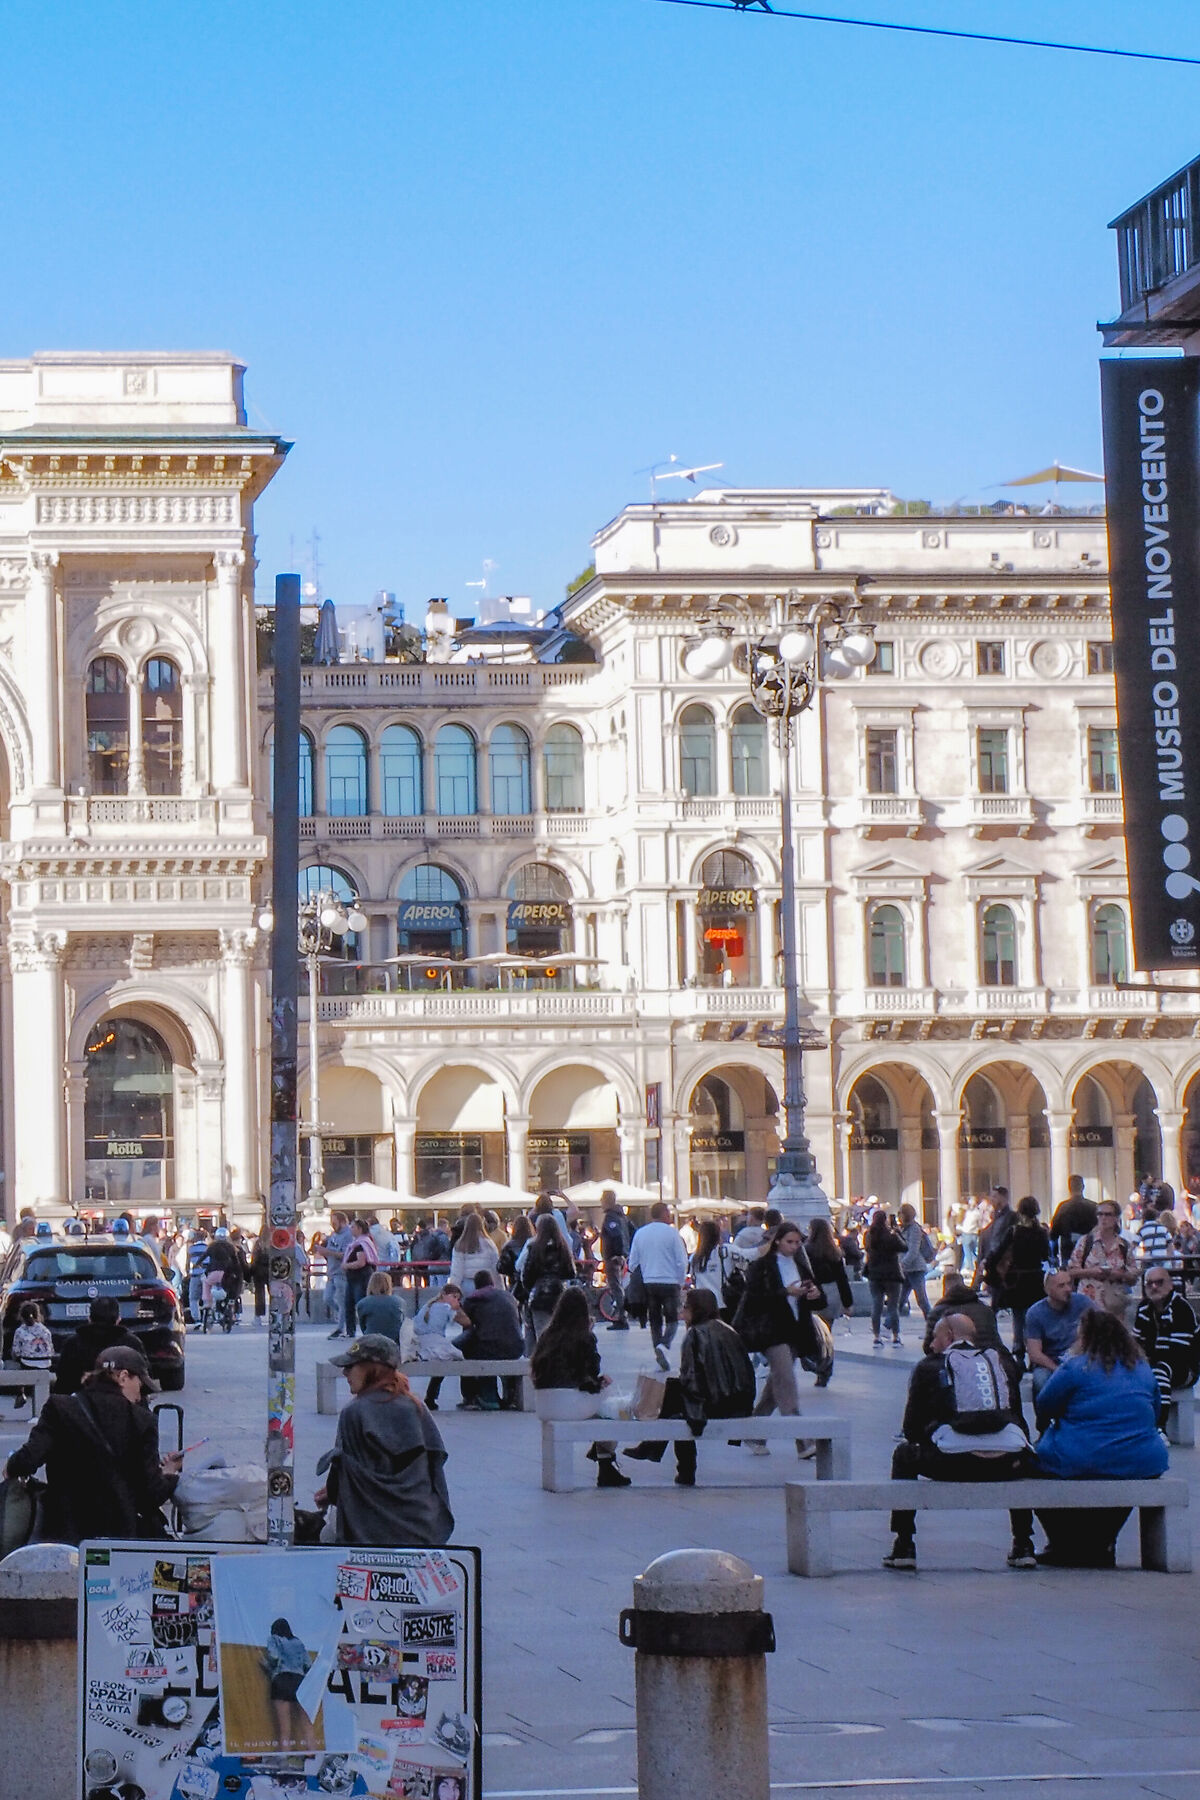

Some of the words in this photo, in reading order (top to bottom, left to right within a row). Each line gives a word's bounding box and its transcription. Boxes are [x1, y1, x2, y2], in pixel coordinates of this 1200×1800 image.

[1138, 388, 1173, 599] NOVECENTO
[1149, 608, 1177, 671] DEL
[1152, 681, 1186, 801] MUSEO
[700, 889, 753, 905] APEROL
[403, 905, 456, 920] APEROL
[511, 904, 565, 919] APEROL
[107, 1142, 143, 1155] Motta
[321, 1138, 346, 1152] otta
[416, 1140, 439, 1148] CATO
[528, 1139, 548, 1147] CATO
[975, 1361, 994, 1408] adidas
[403, 1614, 454, 1642] DESASTRE
[88, 1702, 103, 1712] LA
[106, 1703, 131, 1715] VITA
